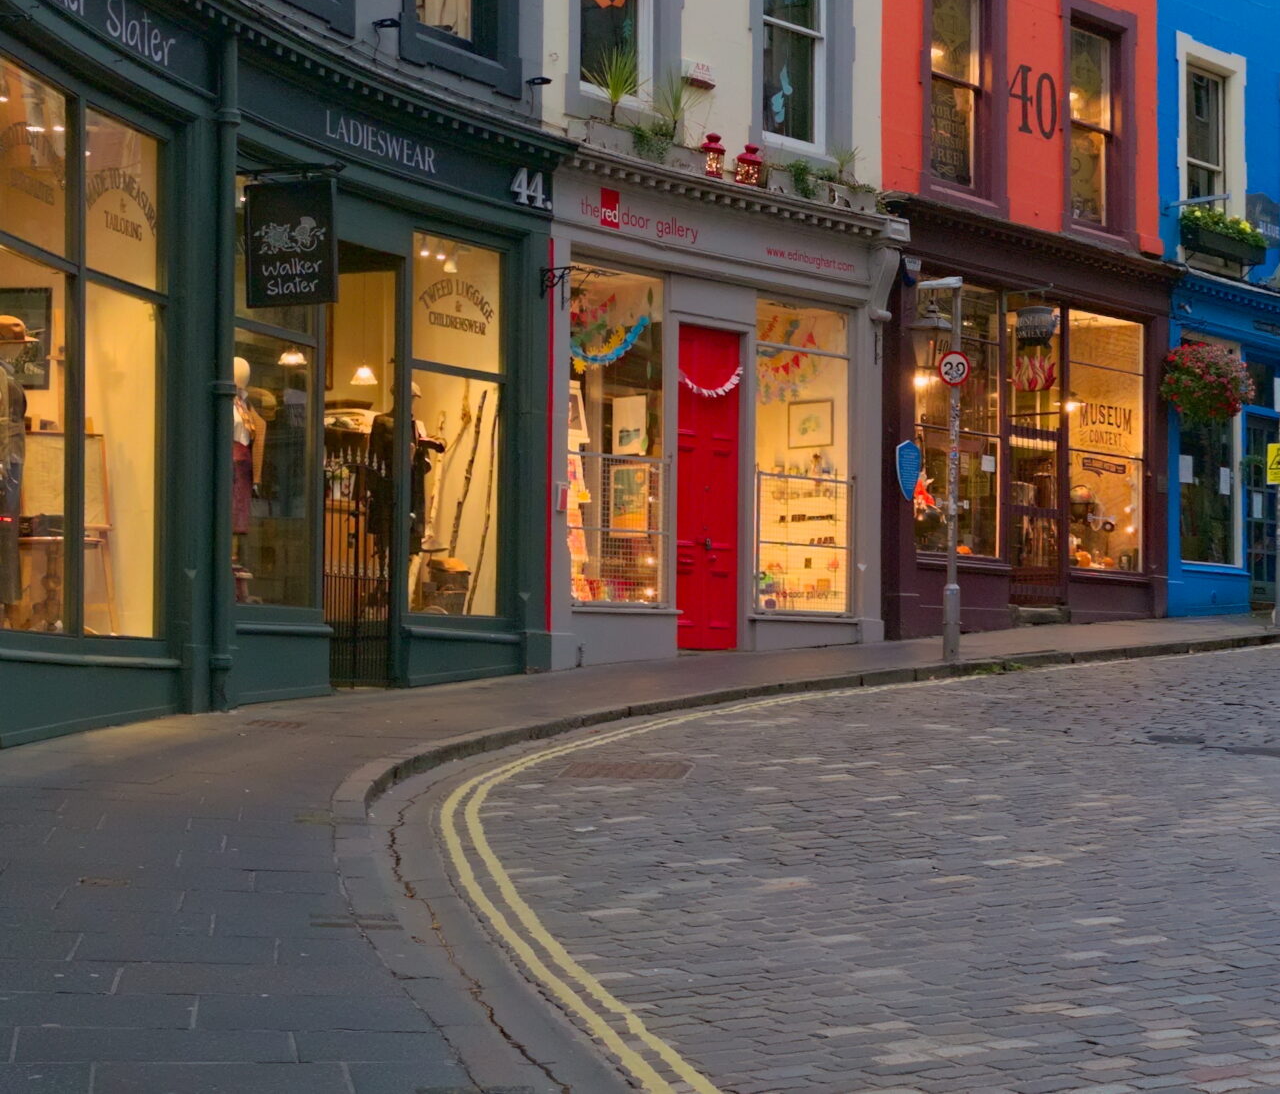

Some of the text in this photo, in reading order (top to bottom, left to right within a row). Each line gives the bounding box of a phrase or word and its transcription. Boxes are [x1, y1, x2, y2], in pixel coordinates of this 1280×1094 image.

[1008, 64, 1058, 141] 40
[326, 109, 436, 174] LADIESWEAR
[104, 210, 143, 242] TAILORING
[581, 195, 698, 245] the red door gallery
[766, 246, 855, 273] www.edinburghart.com
[418, 278, 495, 324] TWEED LUGGAGE
[428, 310, 487, 336] CHILDRENSWEAR
[1079, 402, 1132, 435] MUSEUM
[1089, 429, 1122, 447] CONTEXT
